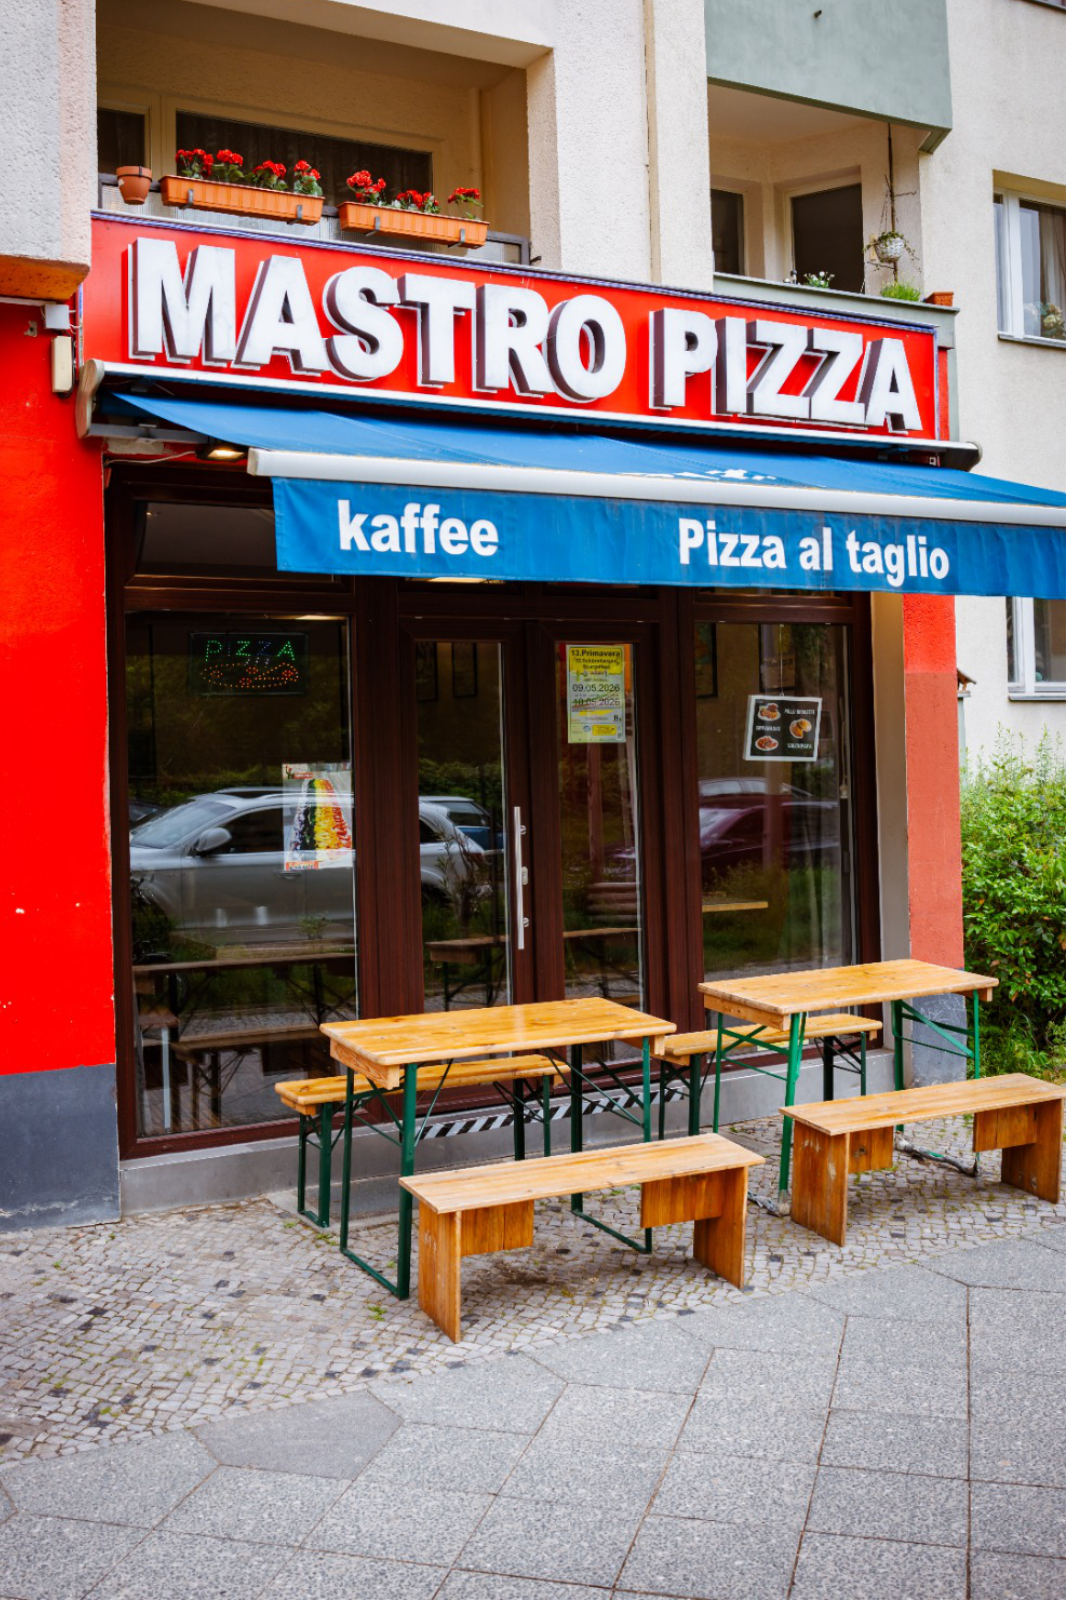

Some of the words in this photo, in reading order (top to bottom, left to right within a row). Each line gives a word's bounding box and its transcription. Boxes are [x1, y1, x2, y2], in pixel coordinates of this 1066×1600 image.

[129, 237, 627, 403] MASTRO
[649, 308, 922, 435] PIZZA
[338, 499, 499, 557] kaffee
[679, 518, 787, 570] Pizza
[799, 527, 834, 572] al
[846, 531, 951, 588] taglio
[205, 639, 296, 662] PIZZA
[572, 684, 621, 692] 09.05.2026
